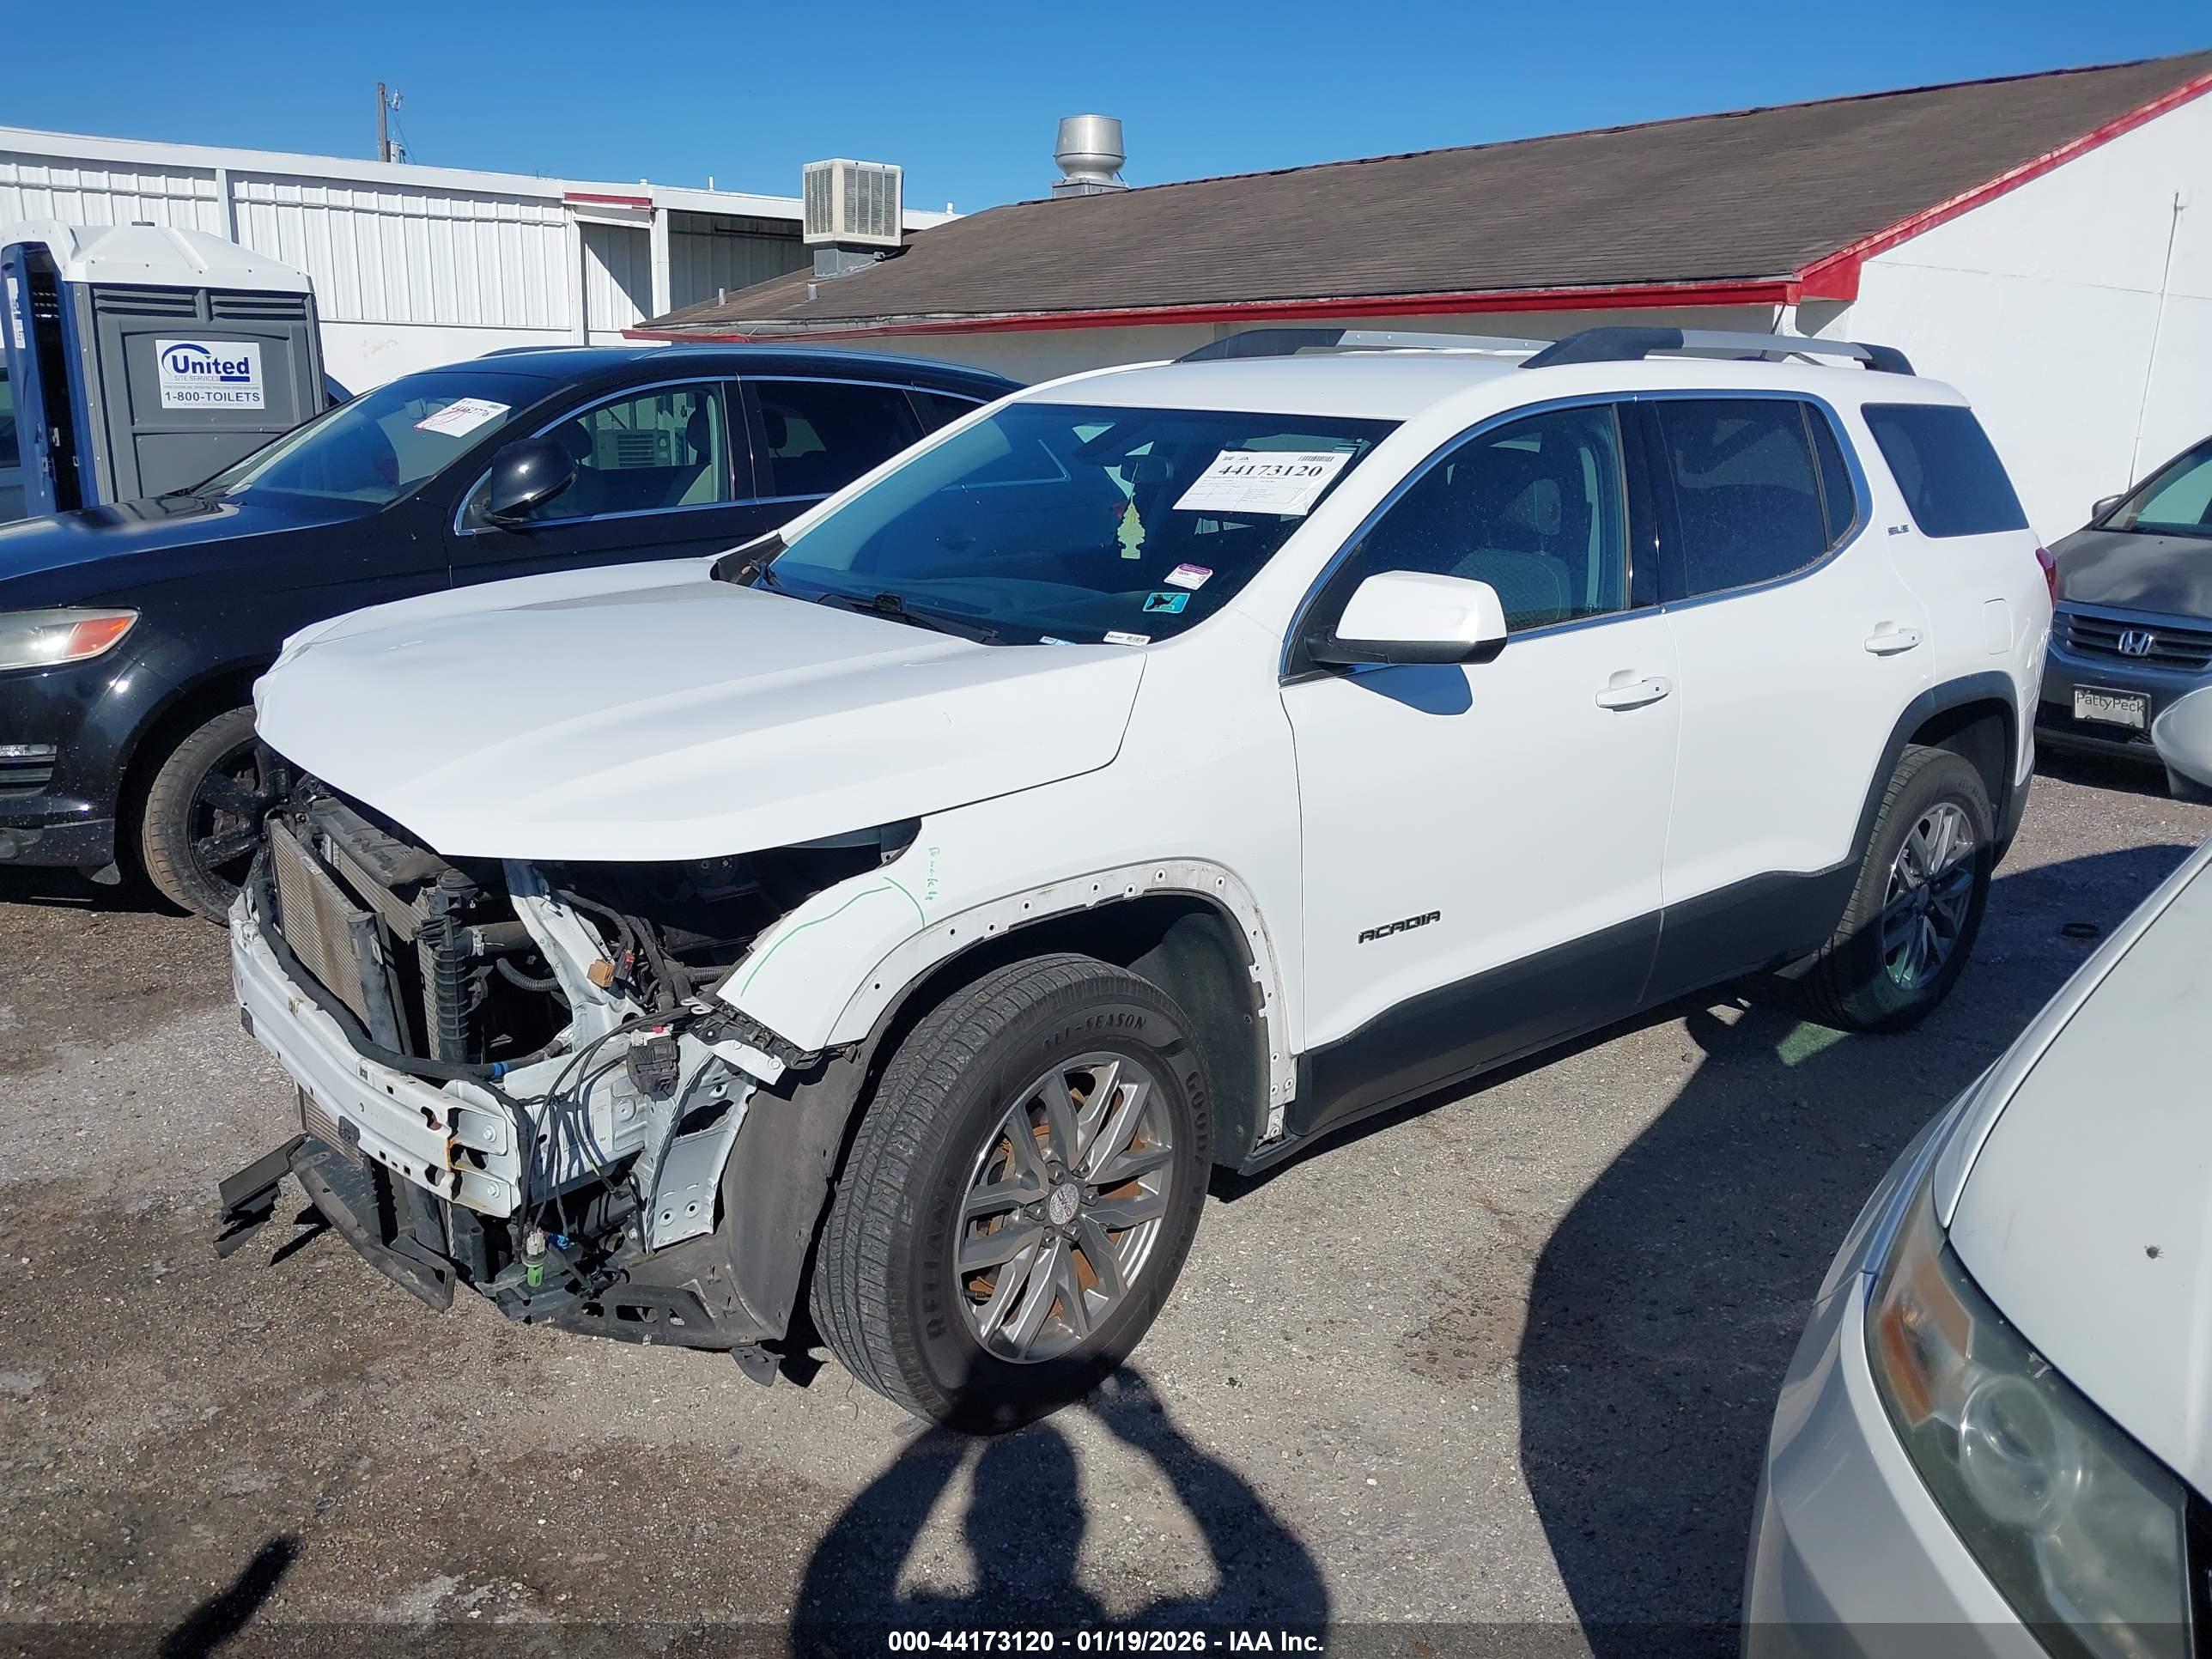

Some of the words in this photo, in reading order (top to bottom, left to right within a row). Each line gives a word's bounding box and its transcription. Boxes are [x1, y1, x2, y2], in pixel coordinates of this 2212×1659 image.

[172, 355, 250, 375] United
[164, 391, 260, 402] 1-800-TOILETS
[1217, 465, 1323, 477] 44173120
[1887, 524, 1910, 536] SLE
[1358, 909, 1441, 945] ACADIA
